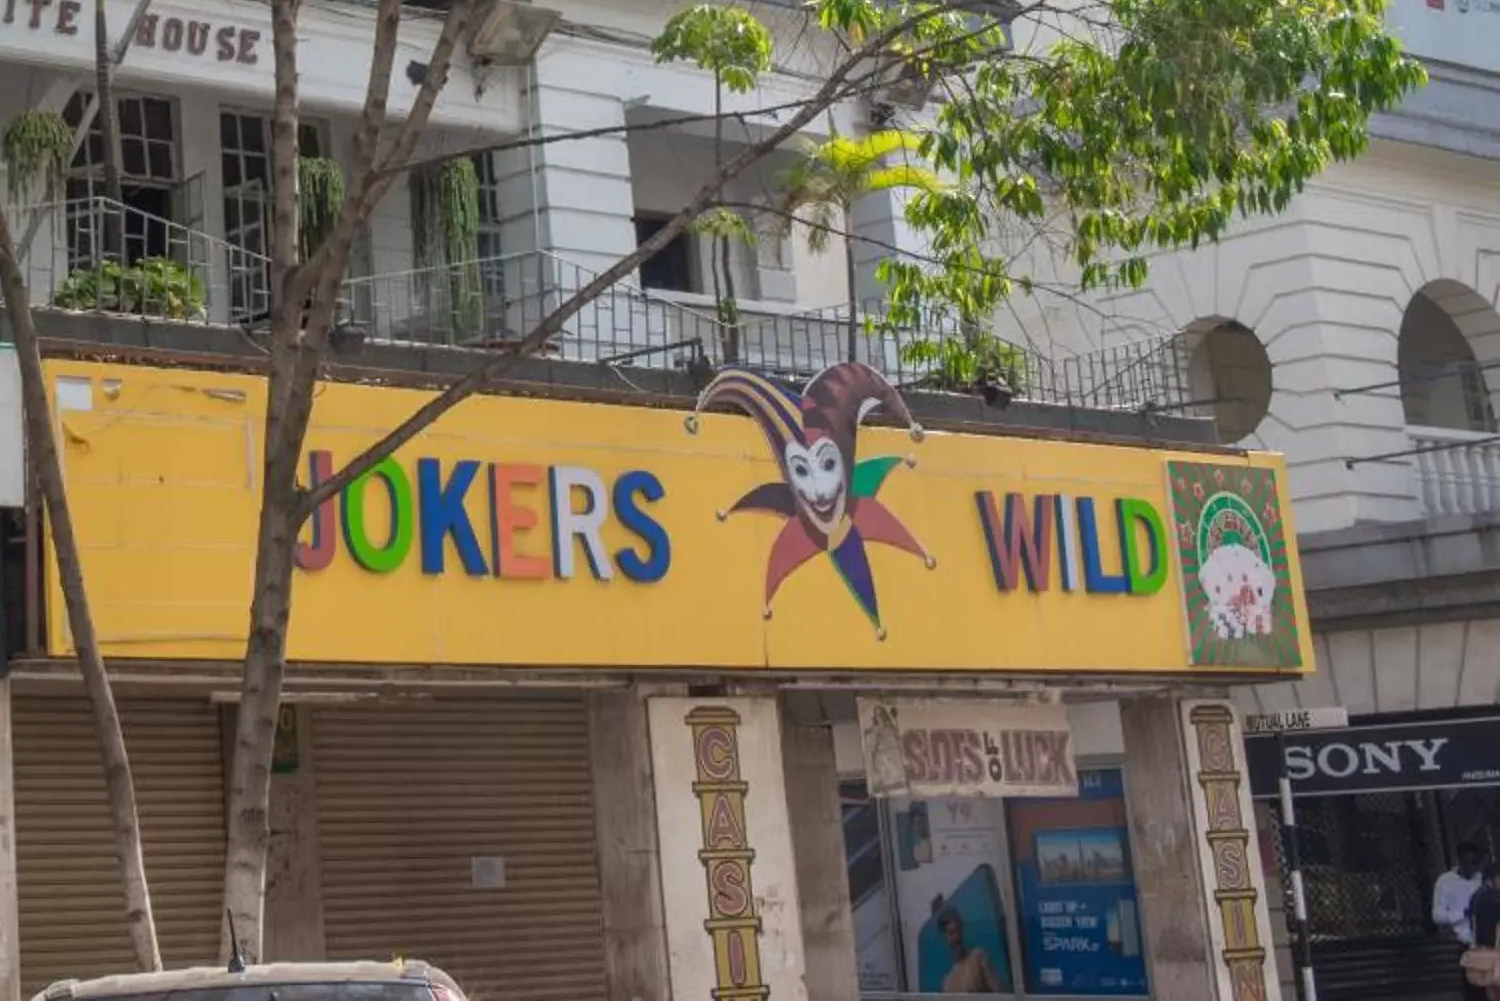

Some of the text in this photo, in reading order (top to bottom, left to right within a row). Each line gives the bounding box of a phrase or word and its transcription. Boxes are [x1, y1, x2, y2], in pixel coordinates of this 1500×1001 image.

[135, 12, 262, 66] HOUSE
[293, 449, 1170, 596] JOKERS WILD
[1001, 729, 1077, 785] LUCK
[1284, 737, 1449, 780] SONY
[699, 725, 758, 1001] CASI
